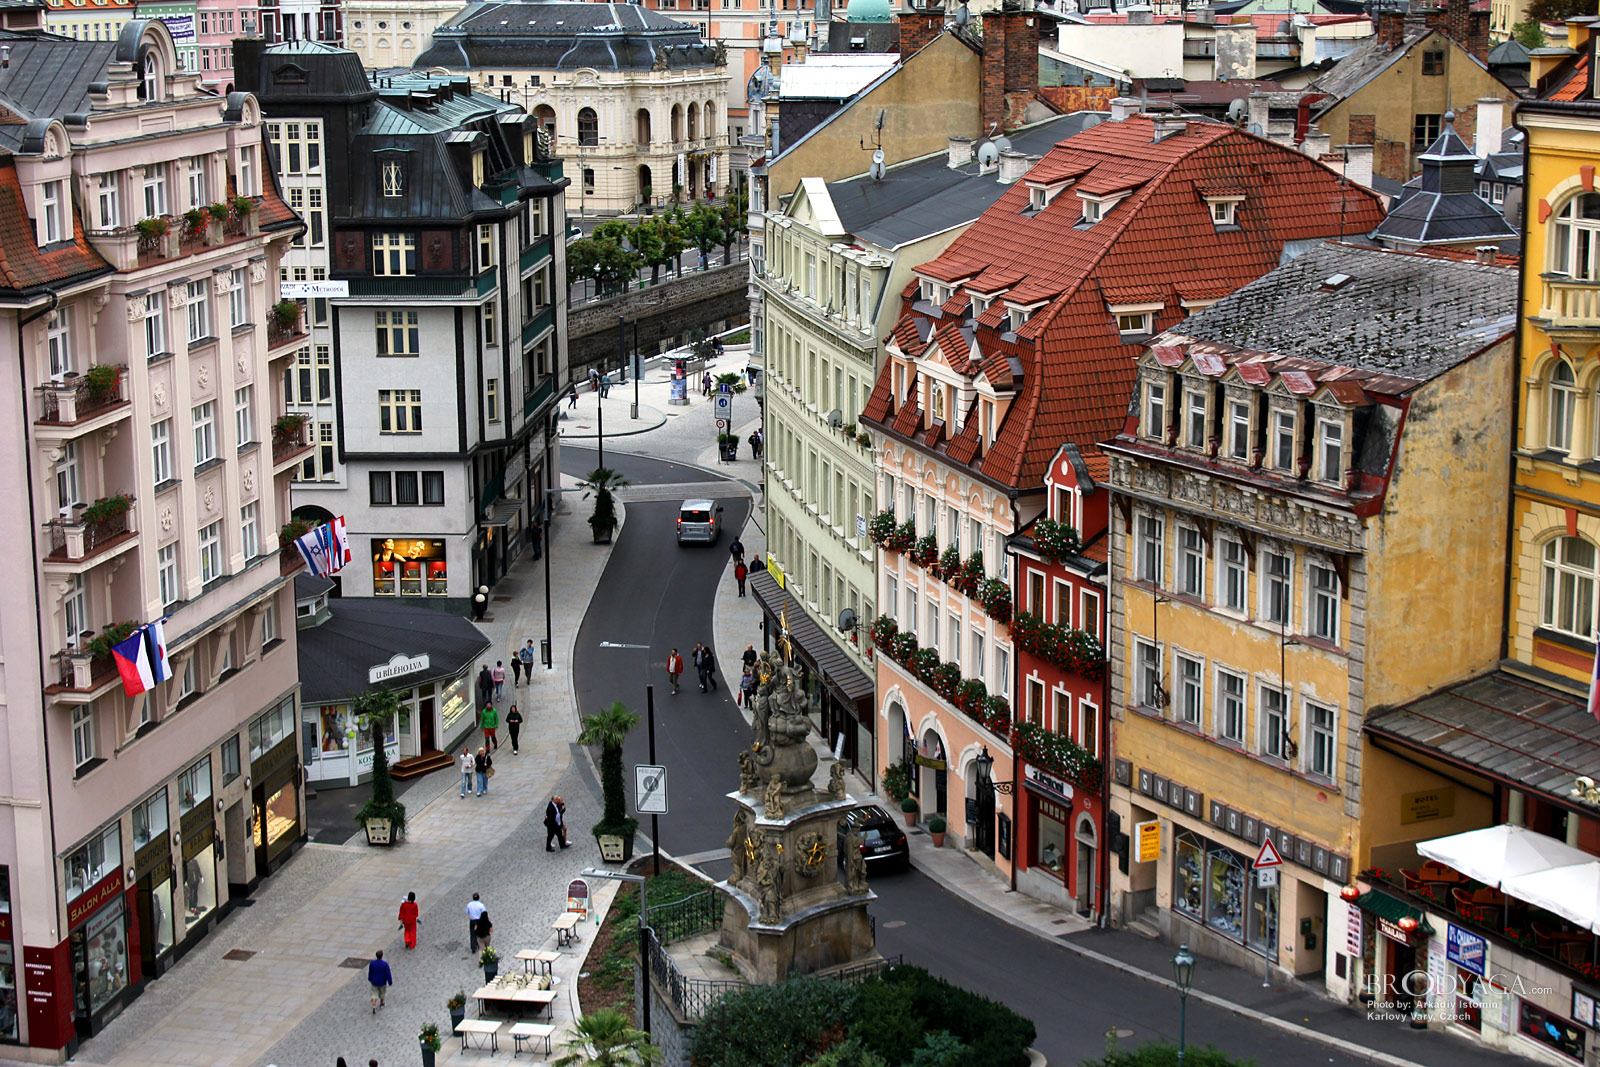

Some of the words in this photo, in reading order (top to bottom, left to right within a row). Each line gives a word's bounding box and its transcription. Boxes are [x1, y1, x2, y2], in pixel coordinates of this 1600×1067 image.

[410, 661, 422, 671] LVA
[1415, 795, 1439, 804] HOTEL
[182, 807, 211, 835] BOUTIQUE
[1143, 774, 1194, 811] SKLO
[1214, 806, 1342, 877] PORCELAN
[136, 843, 168, 871] BOUTIQUE
[71, 895, 99, 922] SALON
[101, 878, 121, 900] ALLA
[1381, 923, 1407, 942] THAILAND
